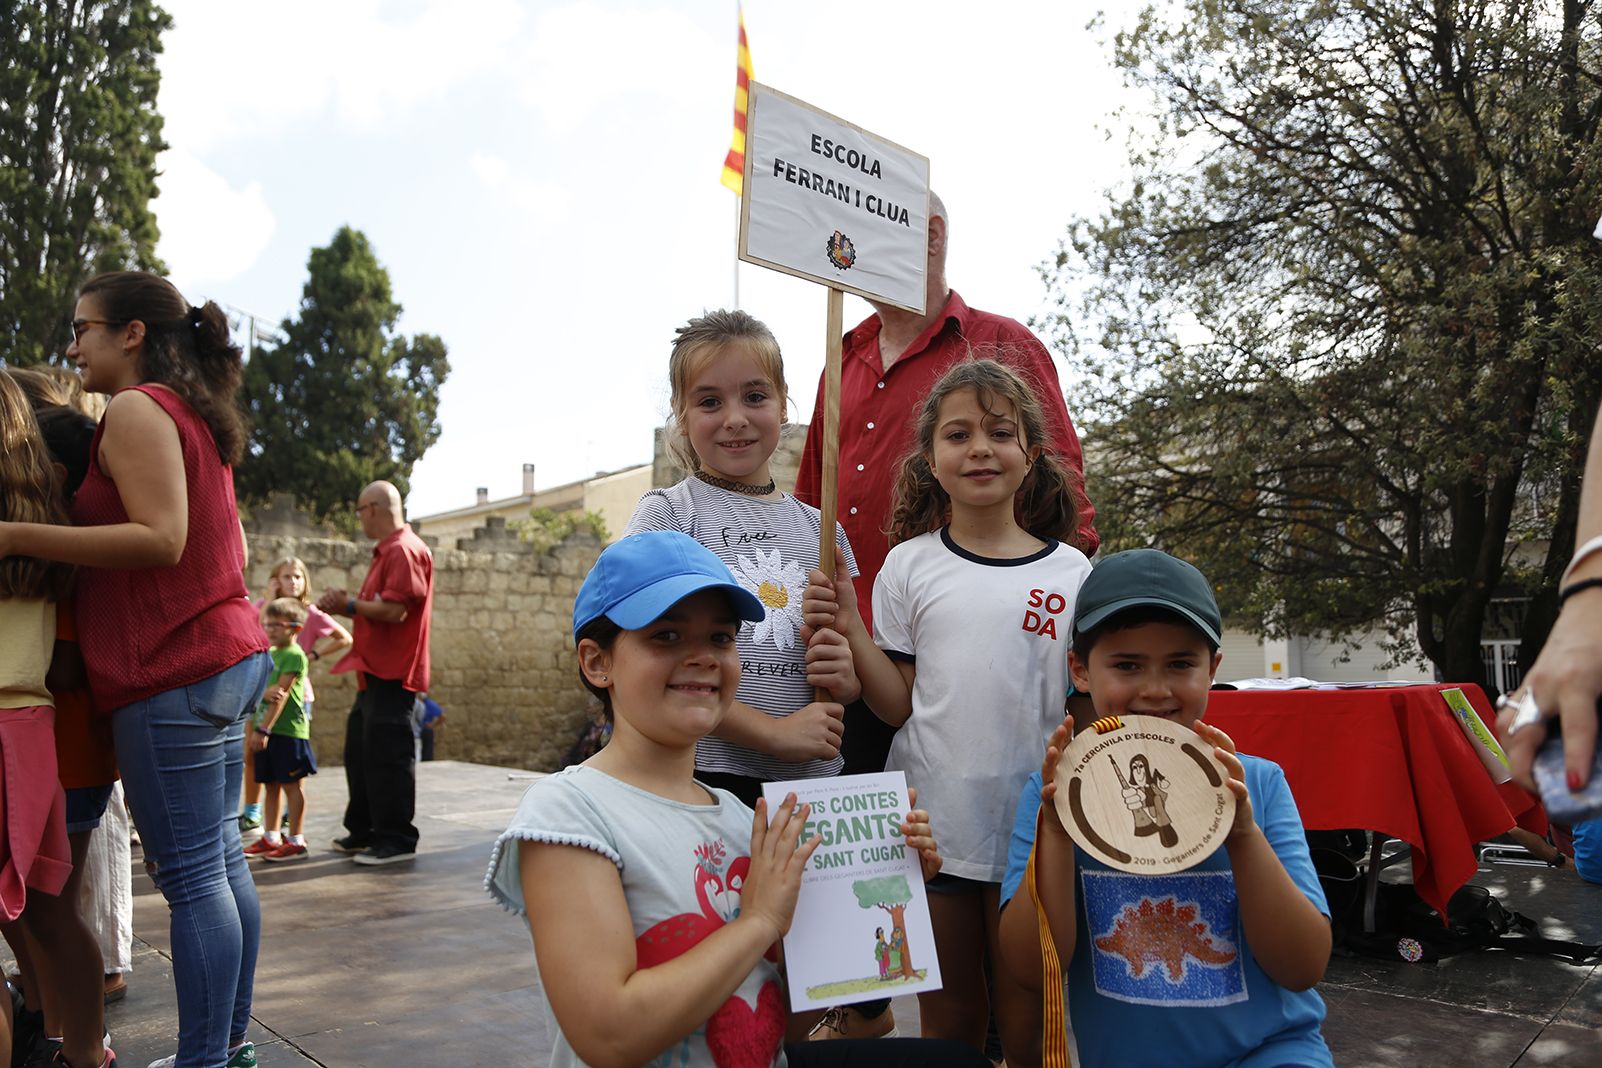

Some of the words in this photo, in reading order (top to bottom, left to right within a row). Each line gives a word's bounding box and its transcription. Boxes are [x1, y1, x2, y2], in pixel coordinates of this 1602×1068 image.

[810, 134, 882, 180] ESCOLA
[773, 158, 850, 204] FERRAN
[855, 190, 861, 208] I
[865, 195, 910, 228] CLUA
[1027, 588, 1066, 614] SO
[1022, 610, 1057, 641] DA
[742, 661, 803, 676] REVER
[1081, 736, 1124, 764] CERCAVILA
[1124, 733, 1176, 745] D'ESCOLES
[830, 791, 899, 814] CONTES
[797, 812, 902, 849] EGANTS
[1134, 857, 1156, 865] 2019
[1163, 843, 1204, 864] Geganters
[1203, 833, 1212, 844] de
[1209, 817, 1221, 833] Sant
[813, 850, 854, 870] SANT
[861, 844, 906, 863] CUGAT
